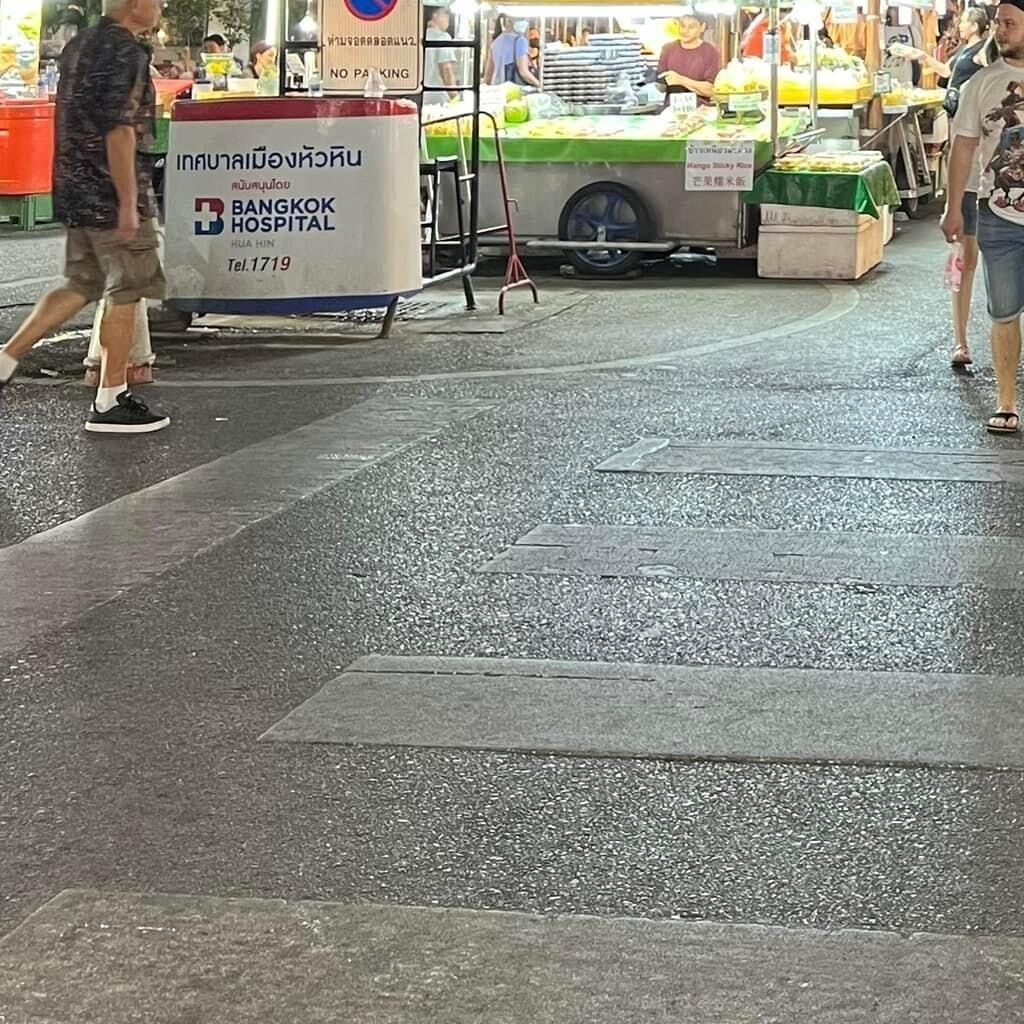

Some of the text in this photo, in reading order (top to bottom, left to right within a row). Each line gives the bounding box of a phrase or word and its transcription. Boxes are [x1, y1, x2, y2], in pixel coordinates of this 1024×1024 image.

[330, 68, 409, 79] NO PAKING
[176, 145, 362, 171] เทศบาลเมืองหัวหิน
[231, 178, 291, 194] สนับสนุนโดย
[232, 197, 336, 216] BANGKOK
[231, 215, 336, 233] HOSPITAL
[231, 239, 275, 249] HUA HIN
